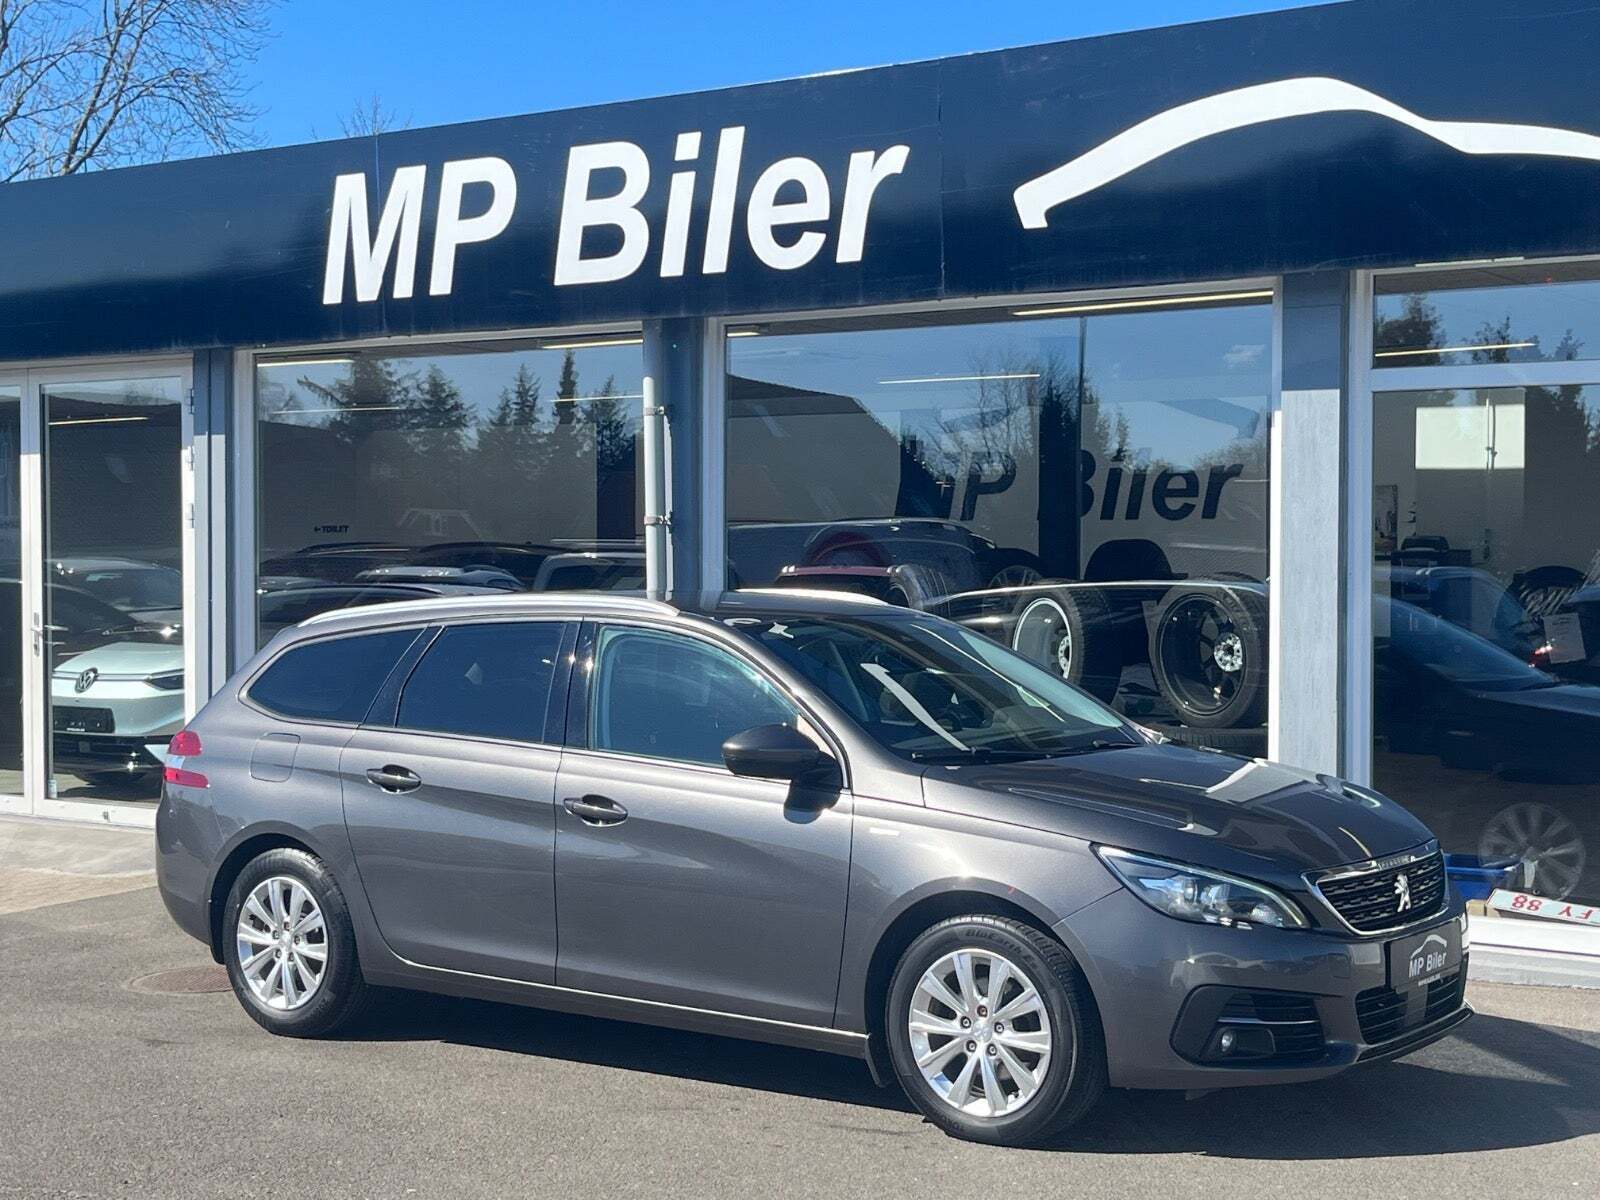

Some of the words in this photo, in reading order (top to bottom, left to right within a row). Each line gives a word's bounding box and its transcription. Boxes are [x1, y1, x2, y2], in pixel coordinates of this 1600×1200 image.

[322, 155, 518, 305] MP
[553, 126, 911, 287] Biler
[1510, 894, 1543, 912] 88
[1408, 956, 1425, 979] MP
[1425, 951, 1447, 972] Biler
